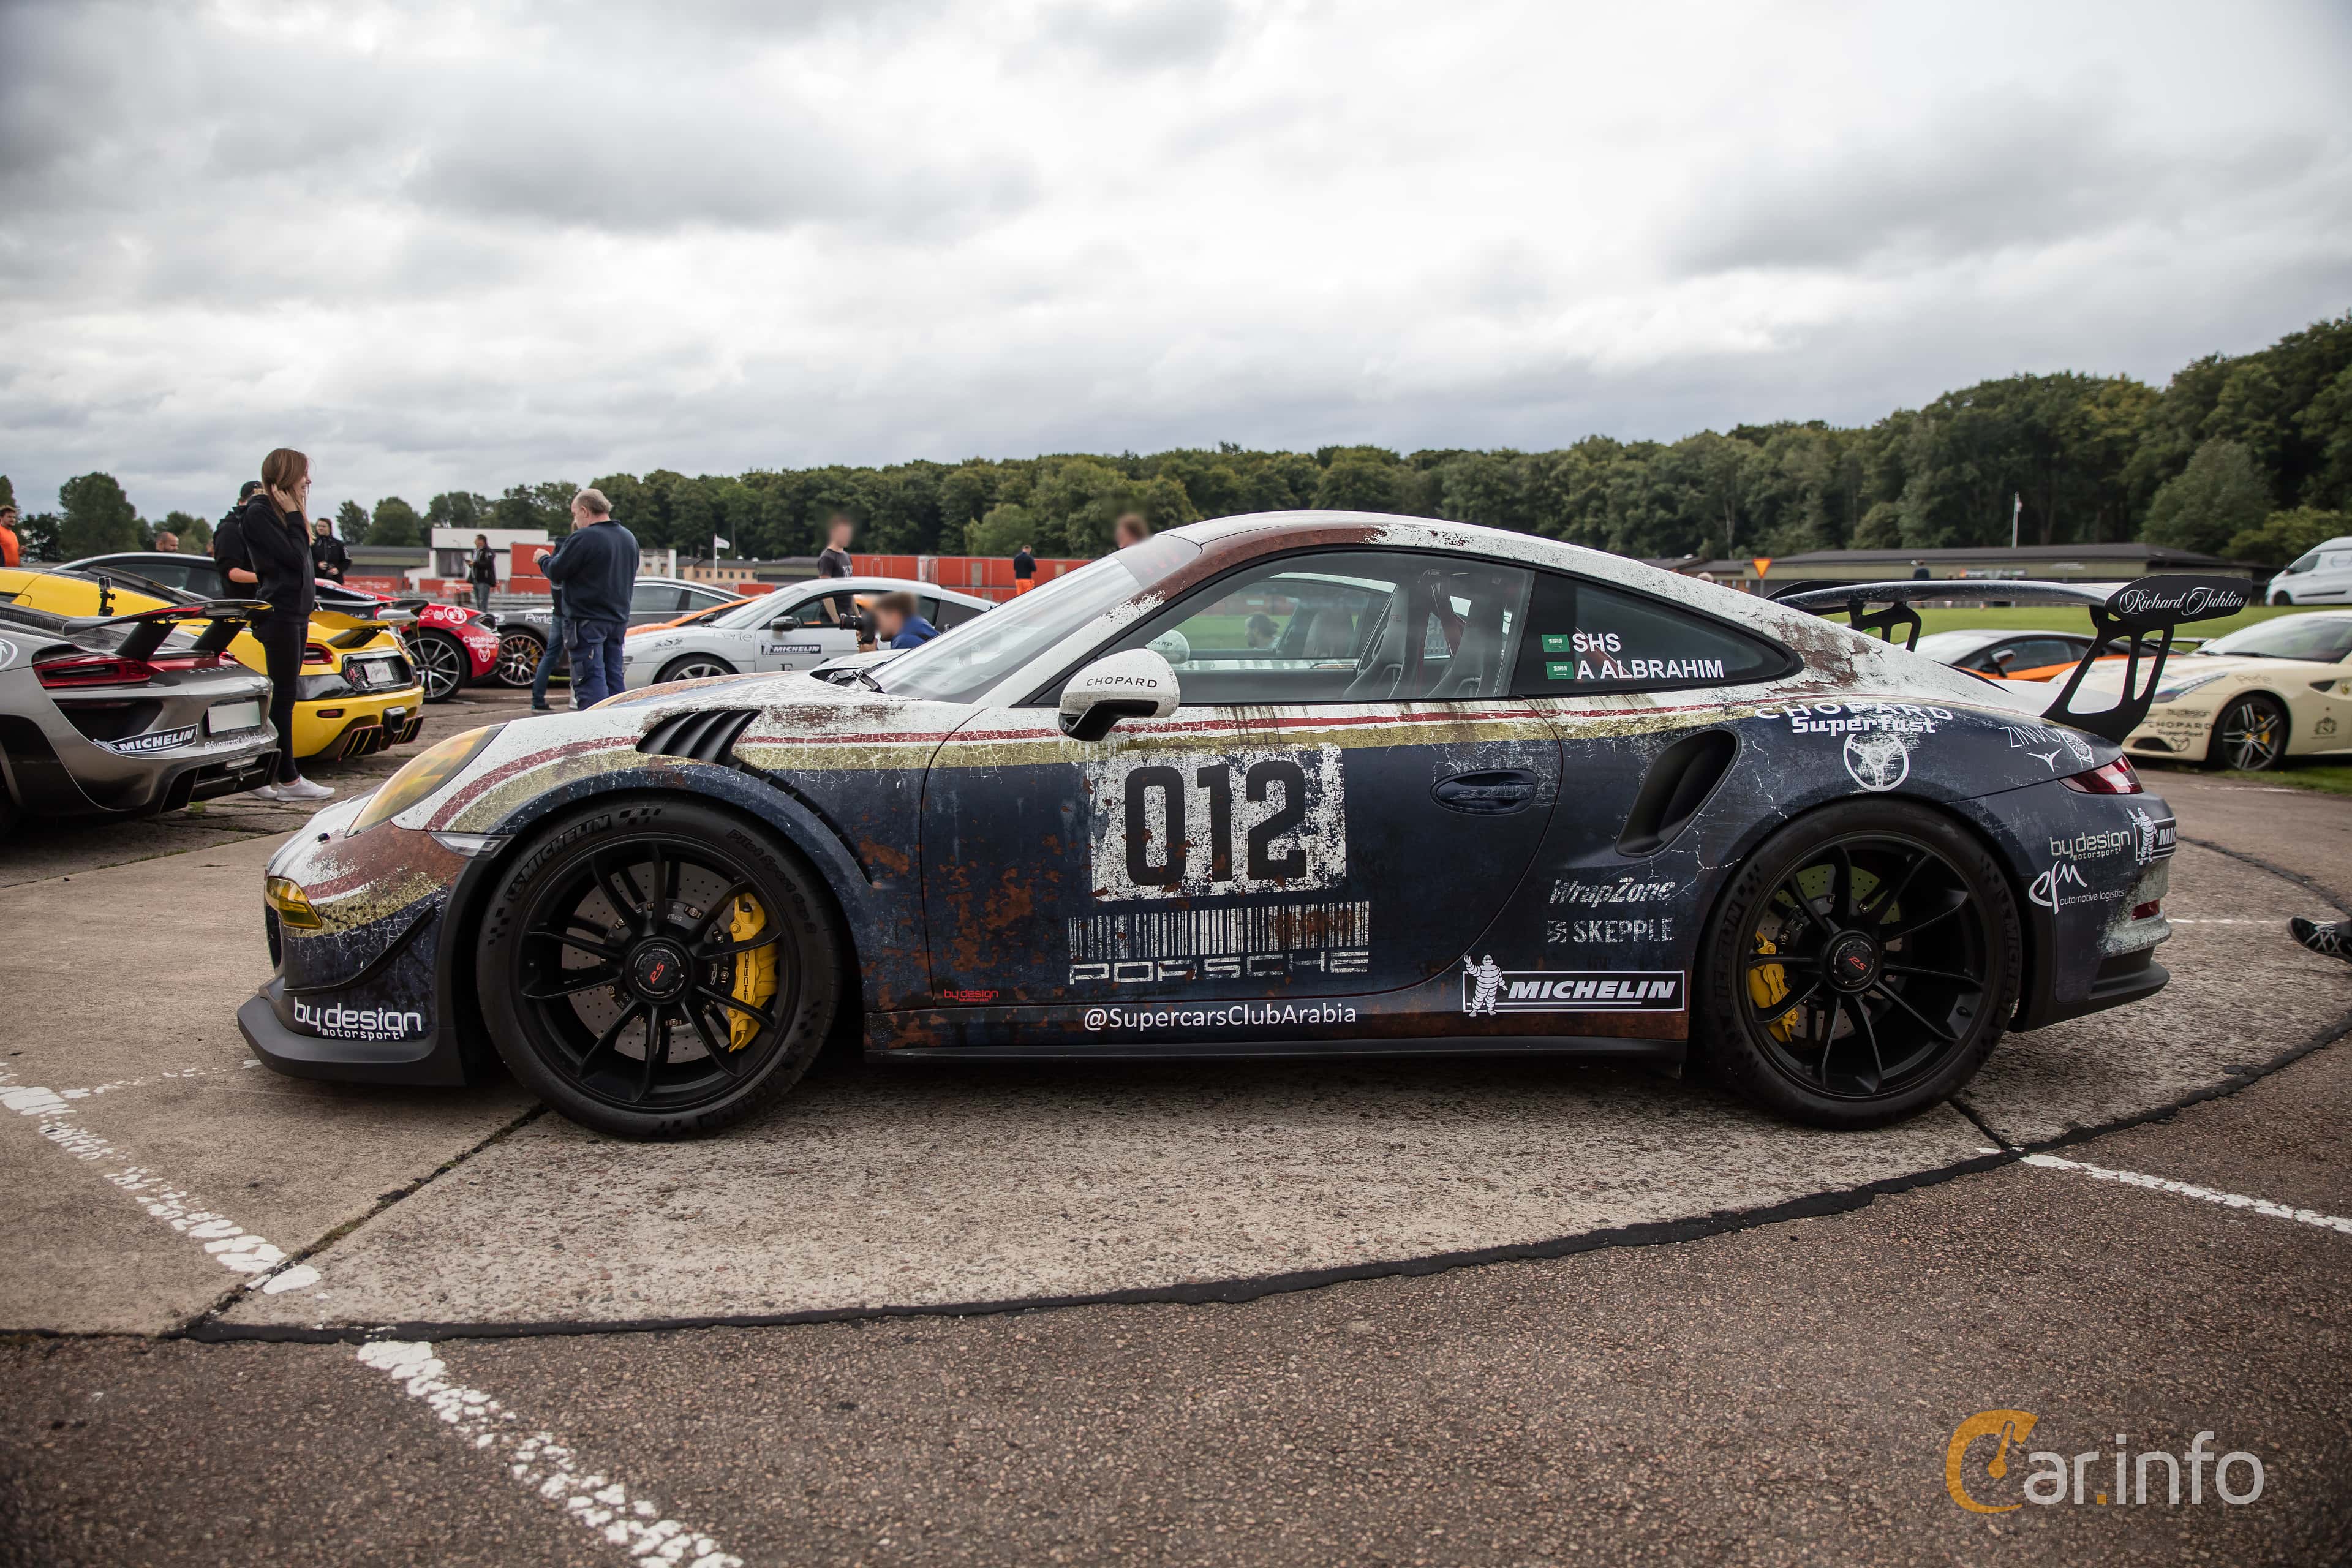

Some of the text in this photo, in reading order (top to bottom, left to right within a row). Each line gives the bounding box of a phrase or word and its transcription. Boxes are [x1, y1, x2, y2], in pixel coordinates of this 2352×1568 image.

[2119, 590, 2187, 614] Richard
[1572, 633, 1621, 652] SHS
[1577, 660, 1725, 679] A ALBRAHIM
[1087, 676, 1158, 688] CHOPARD
[1754, 703, 1954, 720] CHOPARD
[1792, 715, 1937, 736] Superfast
[118, 729, 195, 751] MICHELIN
[1125, 761, 1307, 886] 012
[524, 814, 611, 882] MICHELIN
[2049, 830, 2130, 859] by design
[2073, 848, 2120, 861] motorsport
[1549, 876, 1677, 908] WrapZone
[2060, 889, 2125, 905] automotive logistics
[1572, 918, 1675, 943] SKEPPLE
[1069, 951, 1369, 984] PORSCHE
[944, 989, 998, 1000] by design
[1508, 981, 1676, 999] MICHELIN
[295, 996, 422, 1037] by design
[1084, 1003, 1357, 1031] @SupercarsClubArabia
[322, 1028, 399, 1041] motorsport
